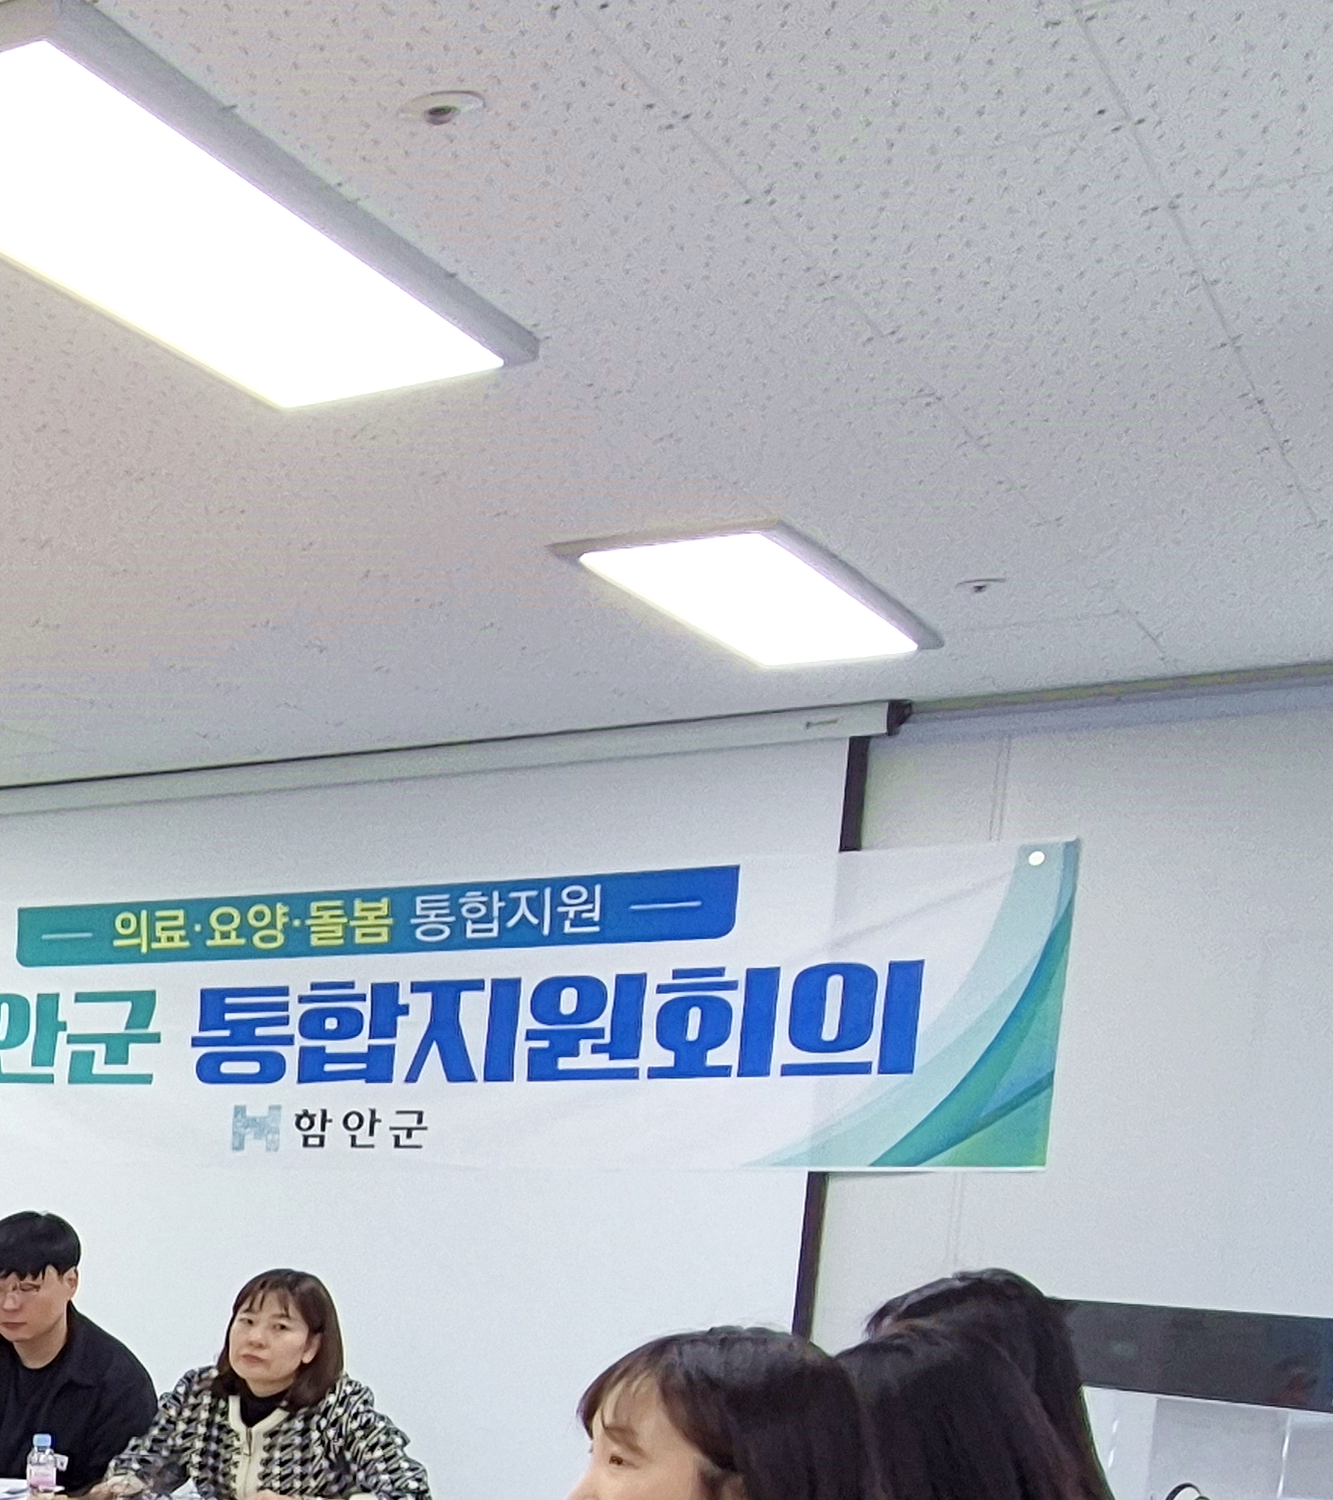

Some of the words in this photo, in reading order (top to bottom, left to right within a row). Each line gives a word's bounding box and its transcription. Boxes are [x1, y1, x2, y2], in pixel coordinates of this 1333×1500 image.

[409, 883, 604, 943] 통합지원
[190, 958, 926, 1085] 통합지원회의
[293, 1106, 429, 1150] 함안군
